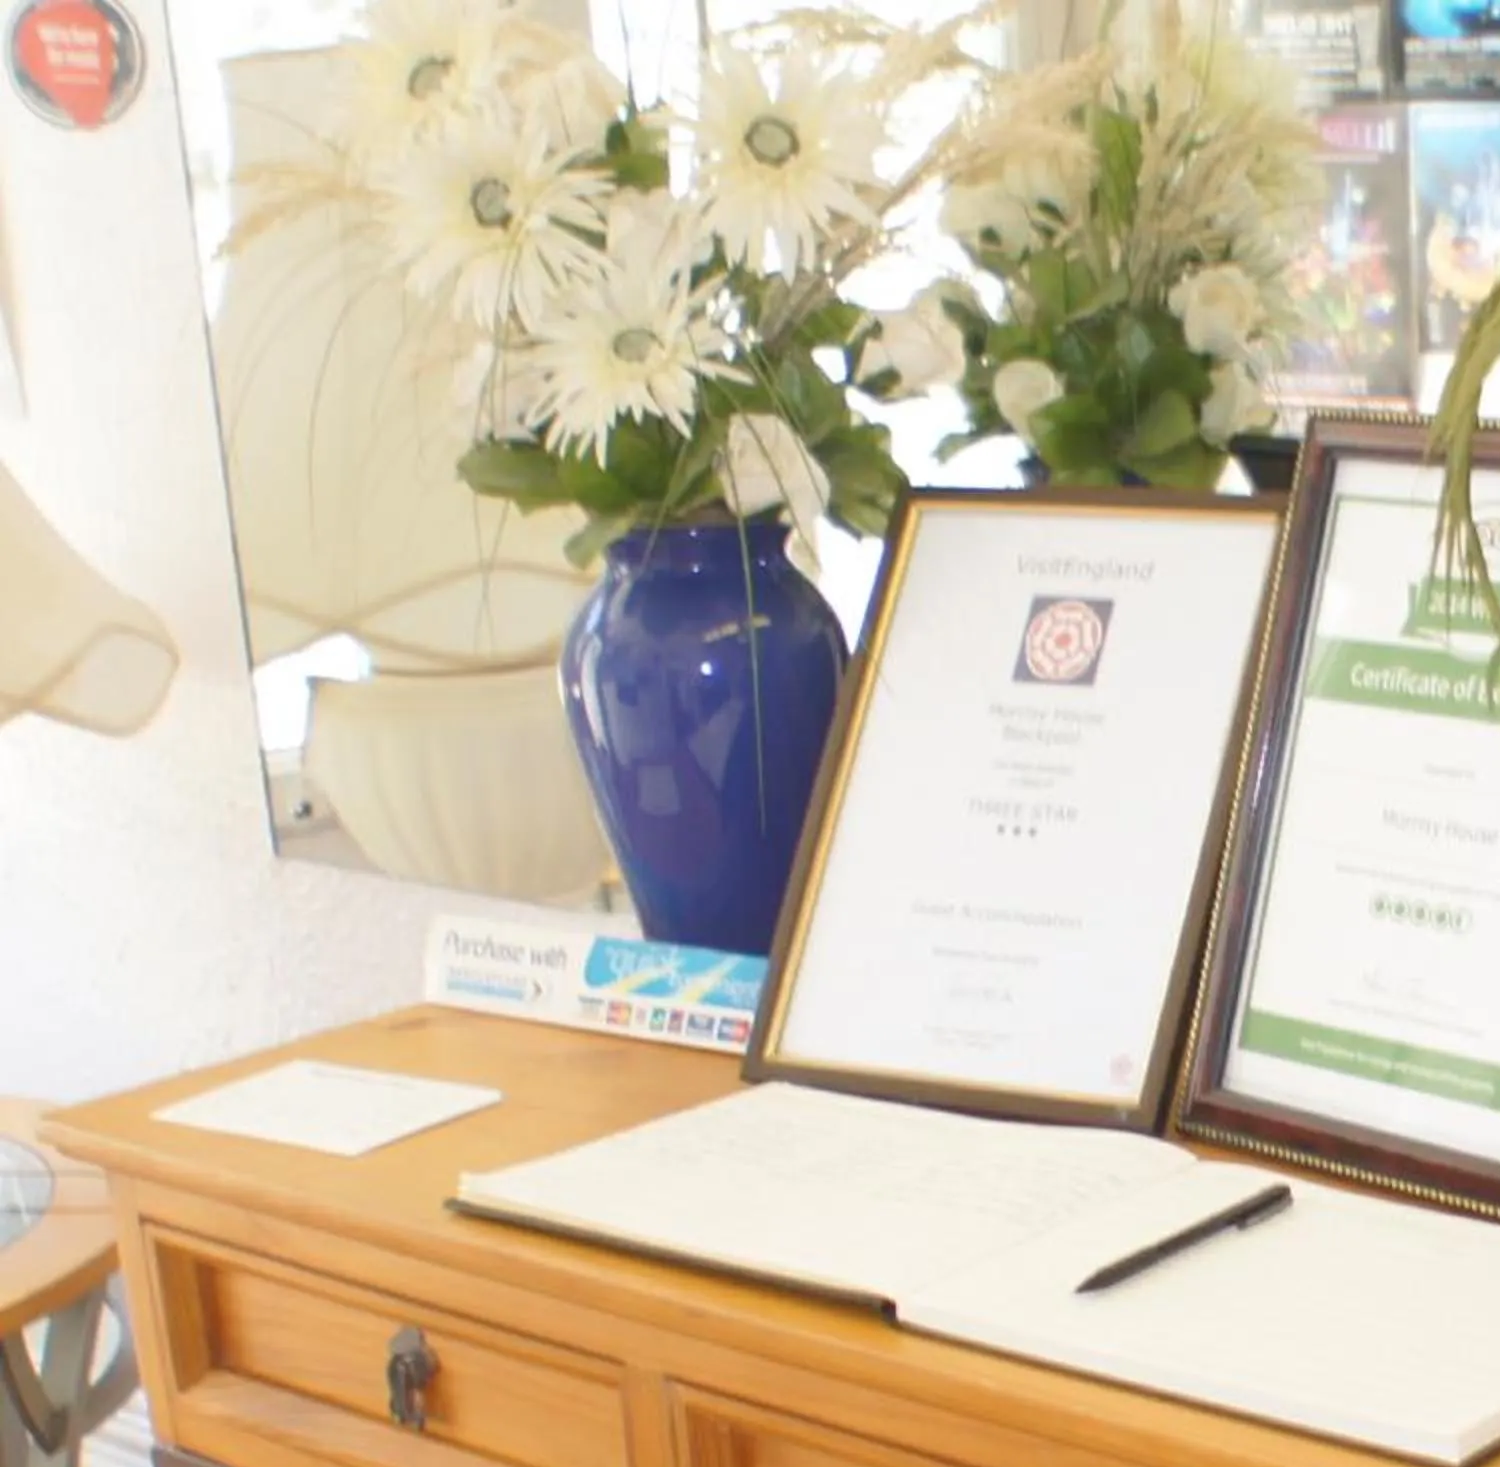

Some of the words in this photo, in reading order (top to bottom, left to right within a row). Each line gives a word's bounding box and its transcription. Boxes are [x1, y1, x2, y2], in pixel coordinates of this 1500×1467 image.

[1017, 553, 1156, 582] VisitEngland
[1351, 661, 1449, 699] Certificate
[1453, 674, 1475, 700] of
[966, 797, 1022, 820] THREE
[1031, 801, 1078, 823] STAR
[443, 929, 524, 964] Purchase
[530, 942, 568, 971] with
